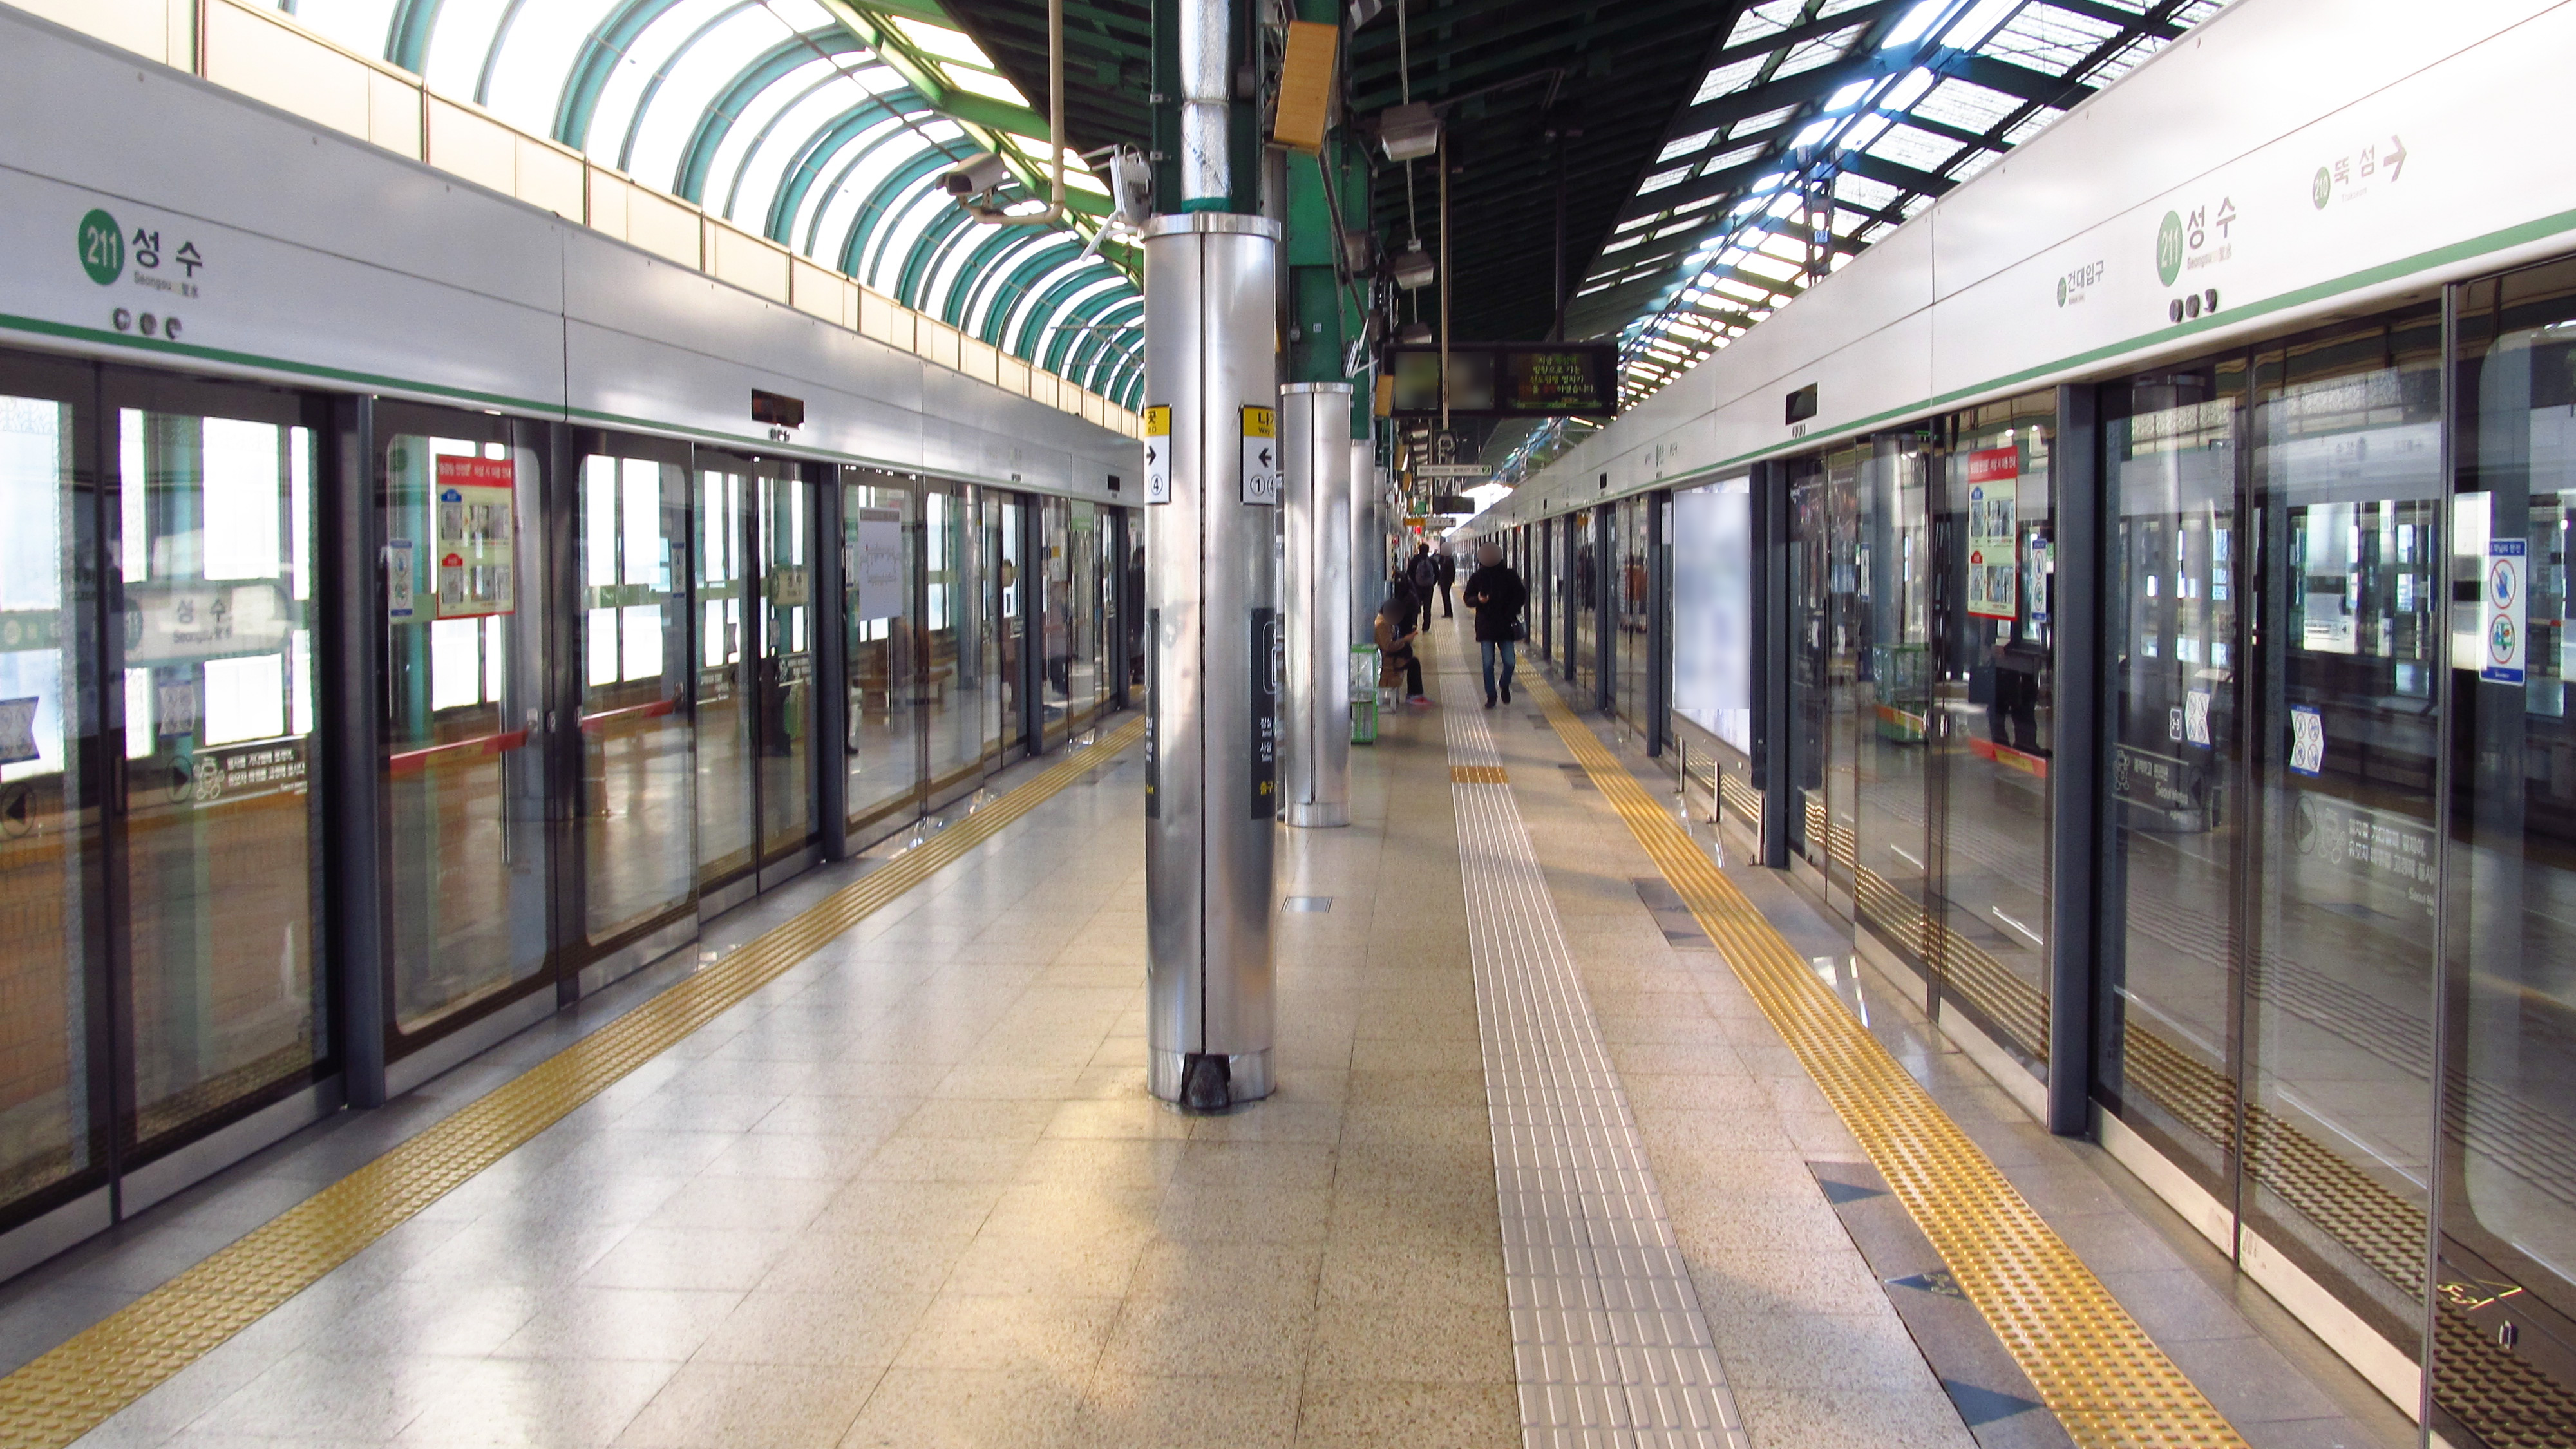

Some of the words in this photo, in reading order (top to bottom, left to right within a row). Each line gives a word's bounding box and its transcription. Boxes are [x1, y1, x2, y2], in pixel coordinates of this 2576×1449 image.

[87, 226, 117, 269] 211
[2161, 227, 2179, 269] 211
[2067, 260, 2104, 293] 건대입구
